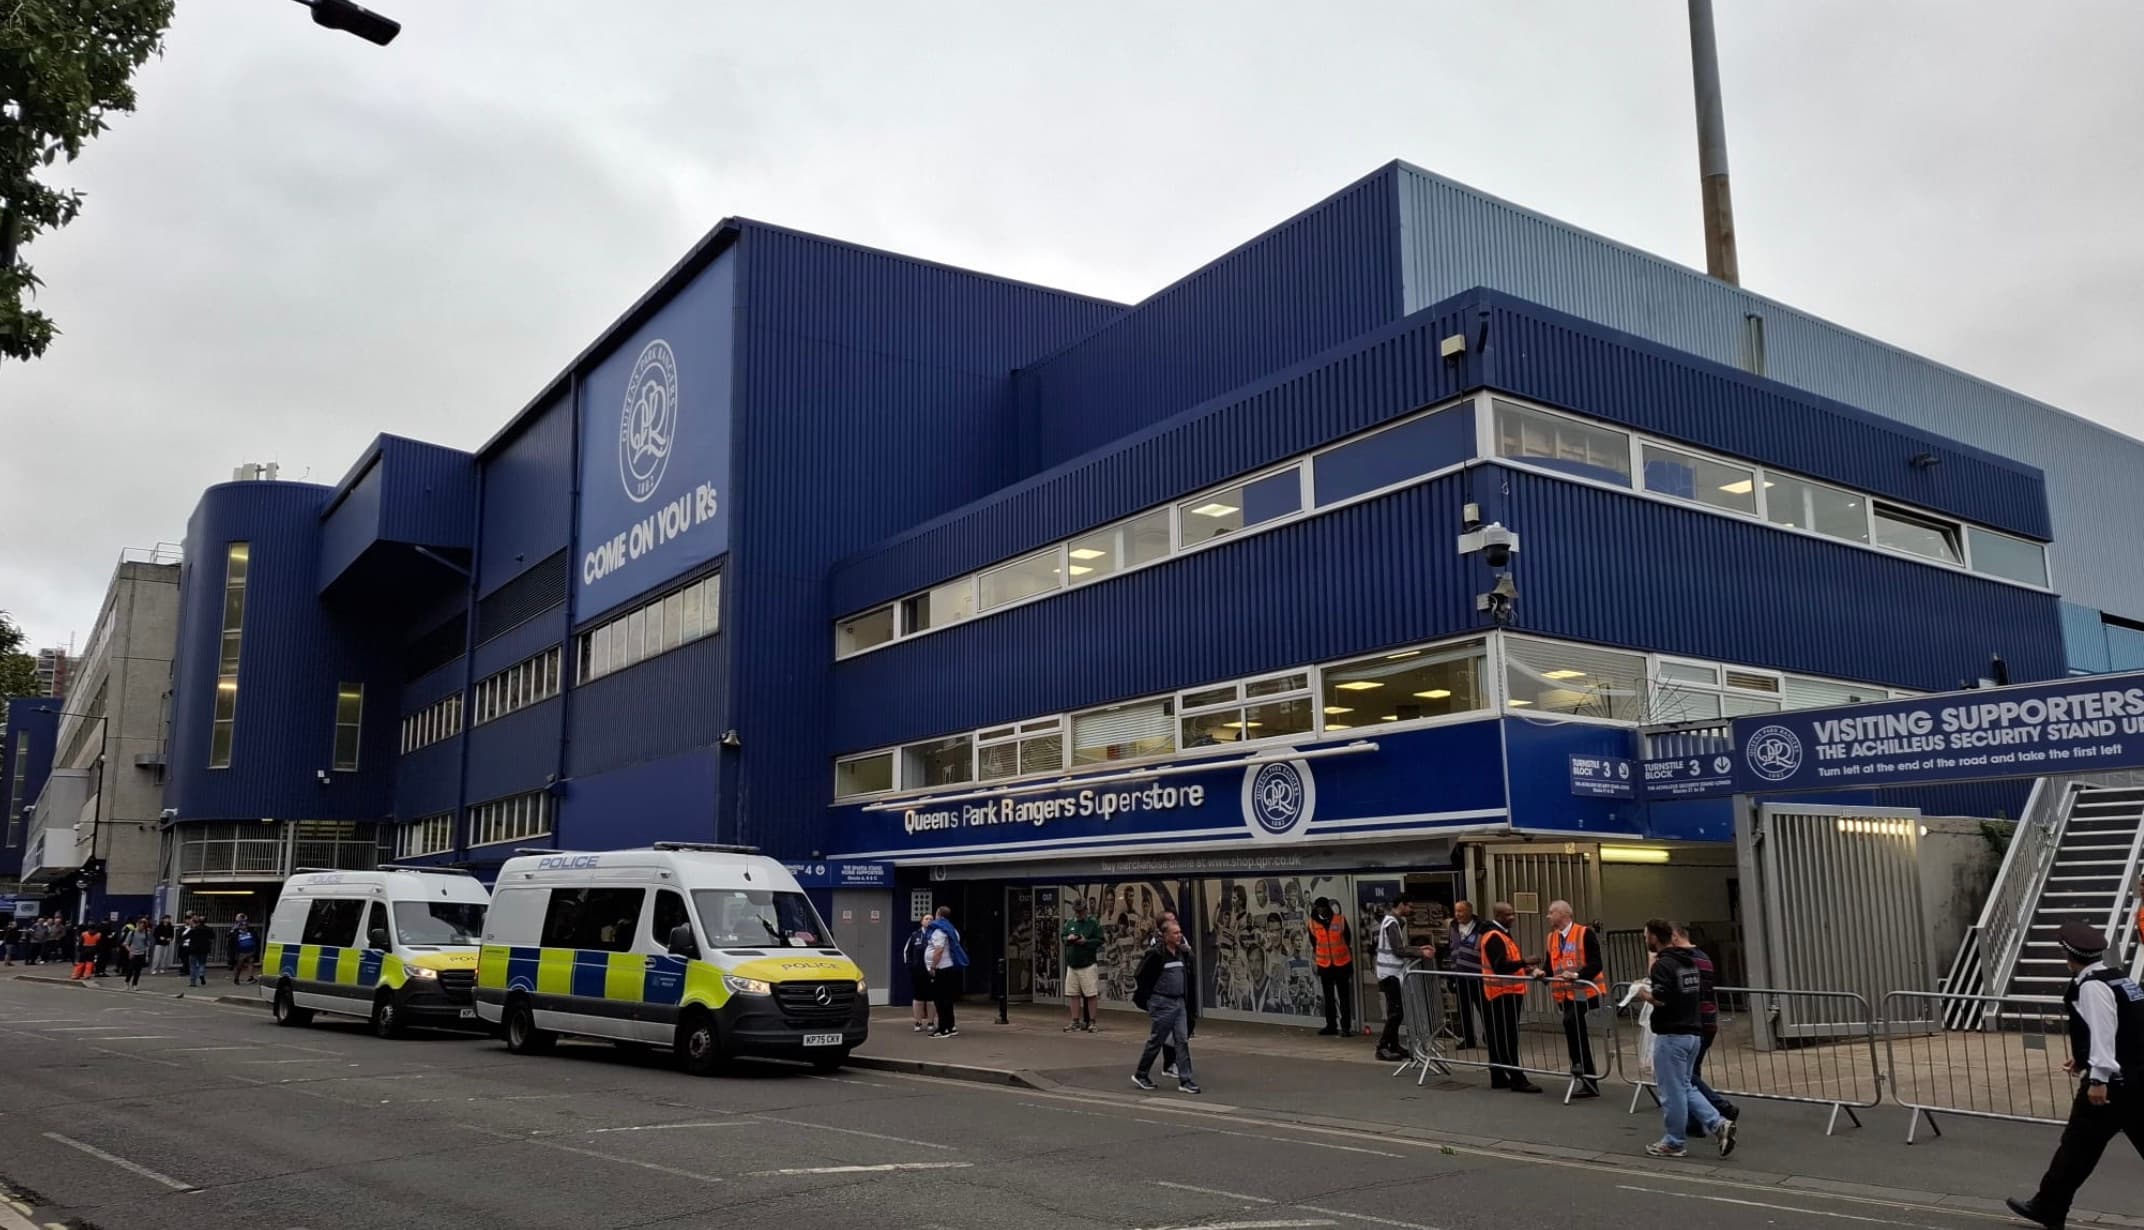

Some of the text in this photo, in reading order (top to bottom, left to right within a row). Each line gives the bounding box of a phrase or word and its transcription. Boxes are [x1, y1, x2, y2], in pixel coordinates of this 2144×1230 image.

[583, 531, 627, 586] COME
[629, 516, 655, 560] ON
[657, 492, 692, 545] YOU
[1812, 688, 2144, 744] VISITING SUPPORTERS
[1816, 743, 1848, 761] THE
[1851, 735, 1945, 758] ACHILLEUS
[1950, 726, 2042, 749] SECURITY
[2047, 719, 2117, 741] STAND
[1603, 761, 1612, 777] 3
[1644, 761, 1684, 773] TURNSTILE
[1689, 759, 1701, 777] 3
[1818, 744, 2122, 778] Turn left at the end of the road and take the first left
[1573, 766, 1593, 776] BLOCK
[1645, 770, 1674, 780] BLOCK
[904, 782, 1205, 835] Queens Park Rangers Superstore
[538, 854, 601, 871] POLICE
[804, 864, 812, 877] 4
[1102, 861, 1115, 873] buy
[1208, 854, 1301, 869] www.shop.qpr.co.uk
[1375, 887, 1385, 897] IN
[781, 960, 839, 971] POLICE
